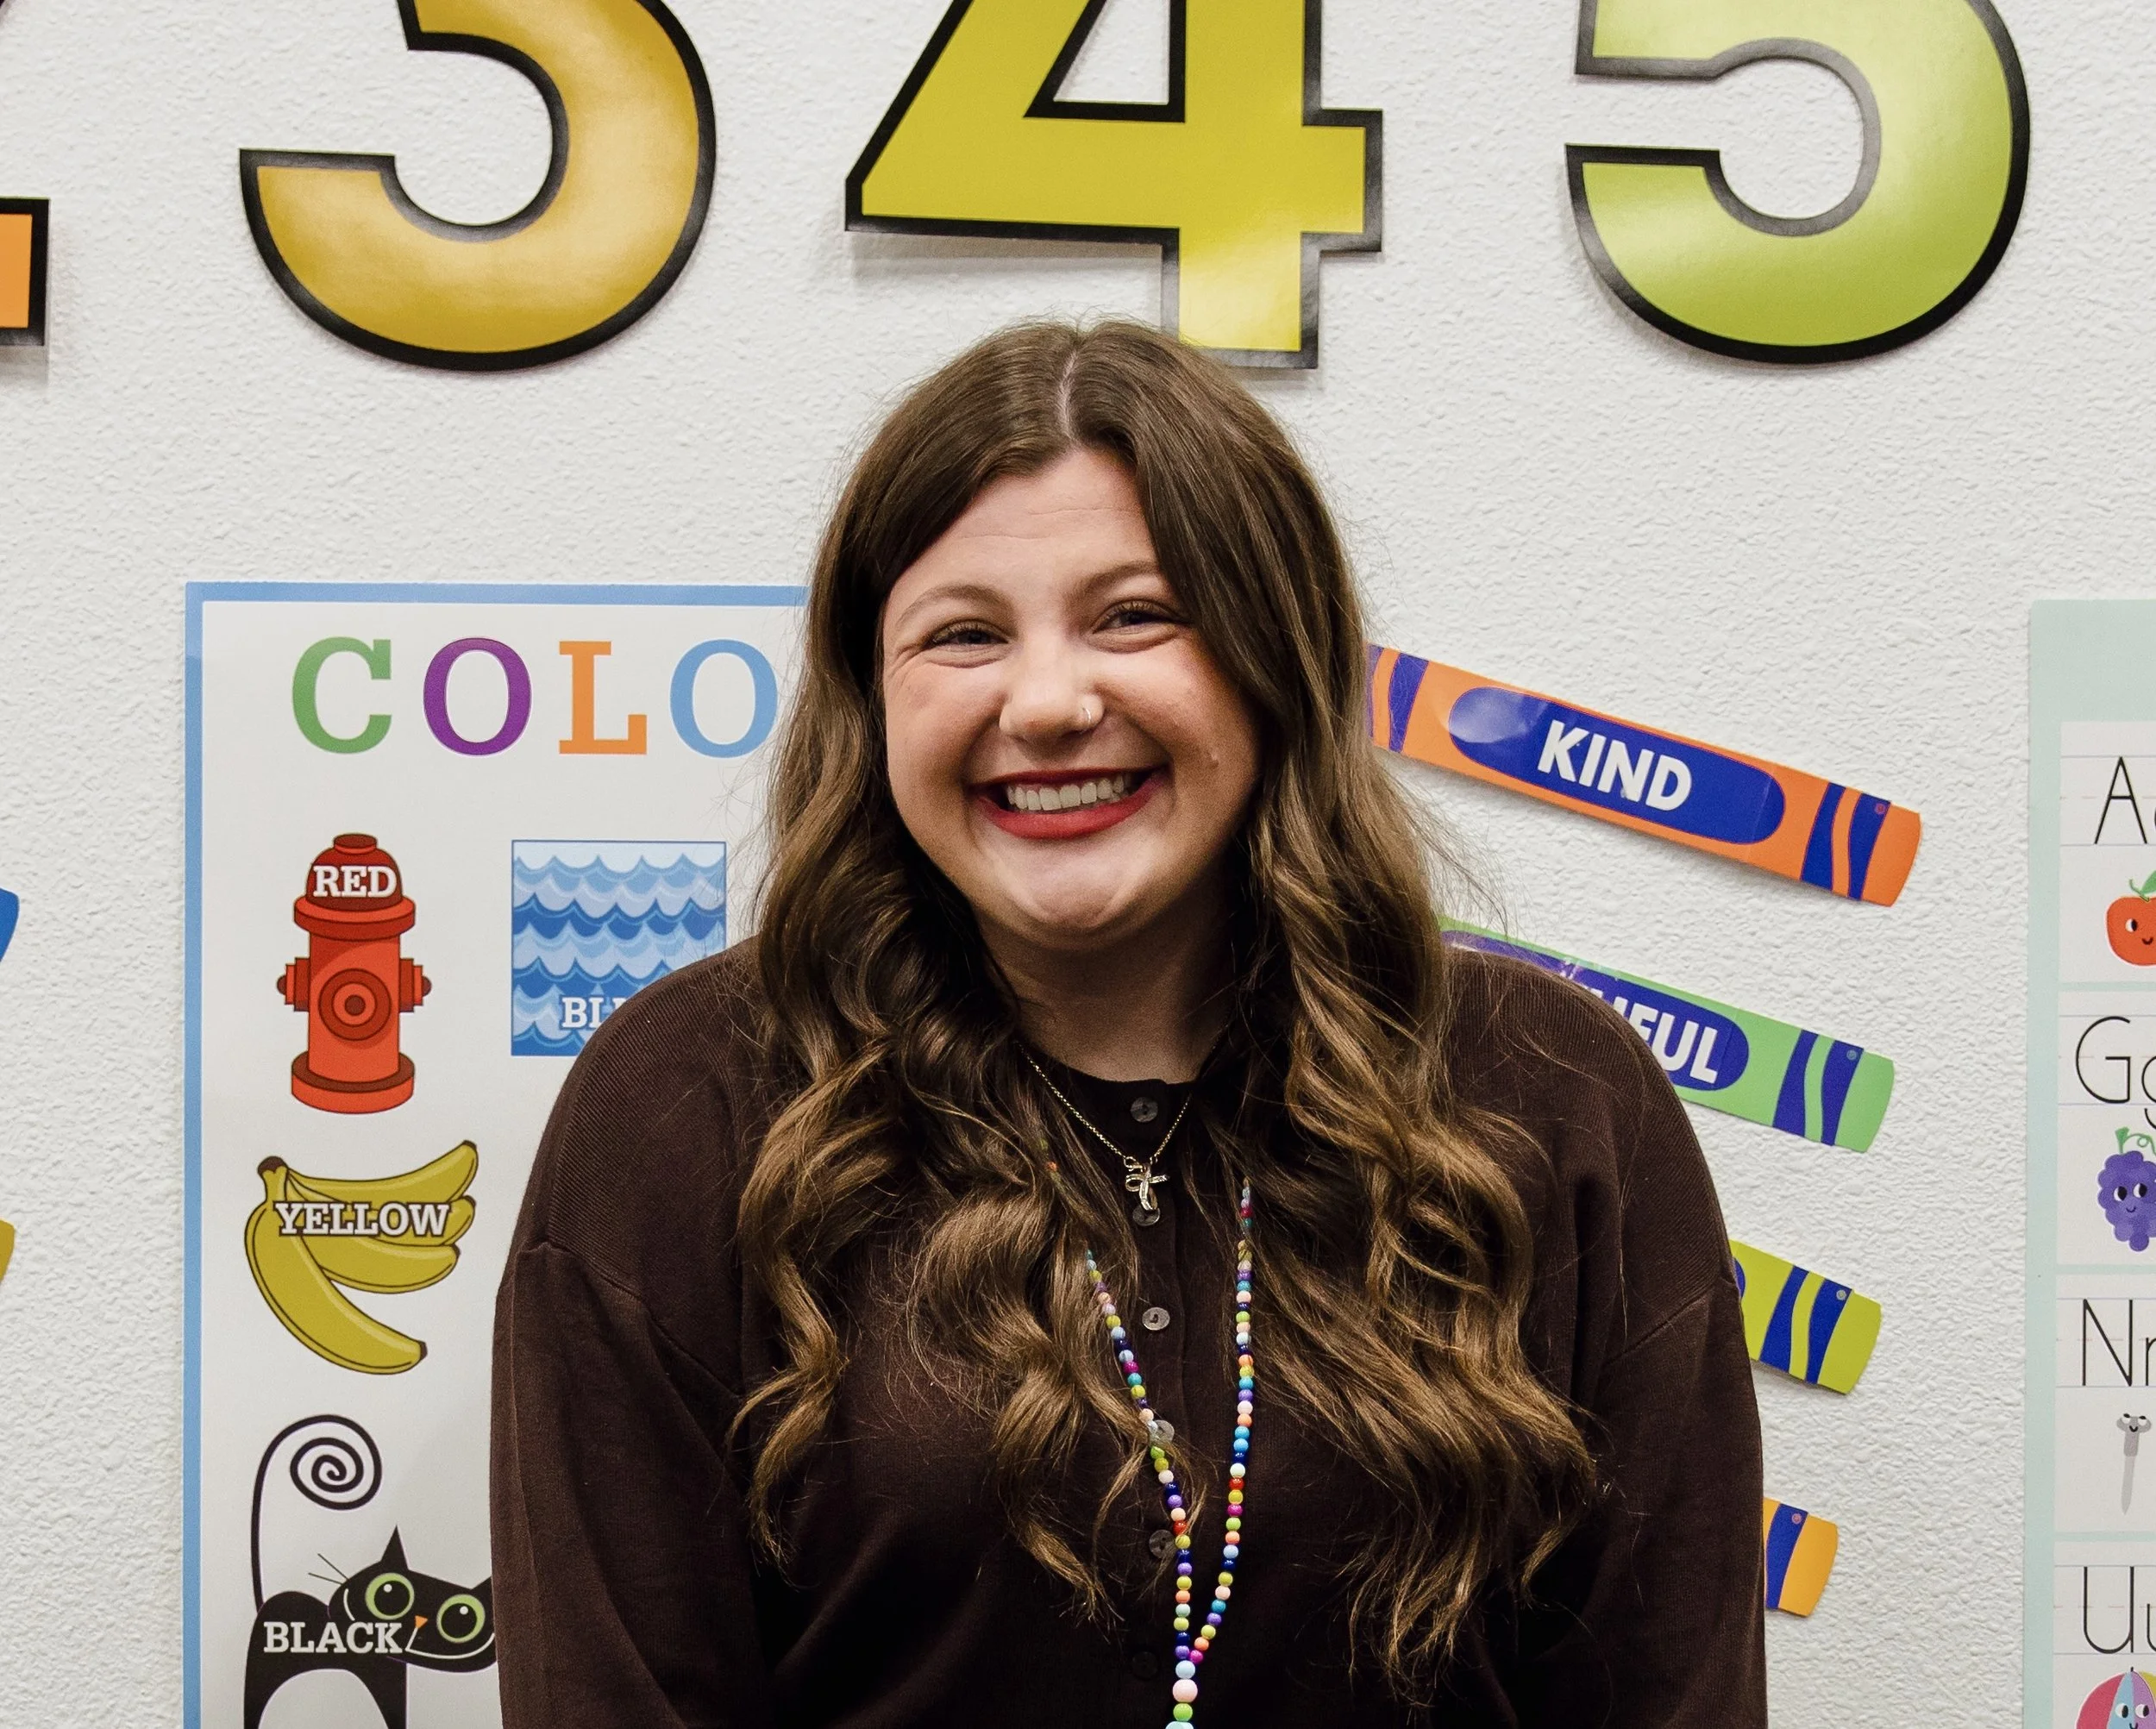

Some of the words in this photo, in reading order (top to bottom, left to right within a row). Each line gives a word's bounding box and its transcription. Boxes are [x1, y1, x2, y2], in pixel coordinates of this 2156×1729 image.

[240, 0, 716, 371] 3
[845, 0, 1382, 369] 4
[1565, 0, 2030, 365] 5
[291, 636, 778, 758] COLO
[1538, 719, 1693, 811] KIND
[2093, 755, 2156, 845] A
[312, 865, 398, 898] RED
[273, 1201, 451, 1237] YELLOW
[263, 1621, 403, 1654] BLACK
